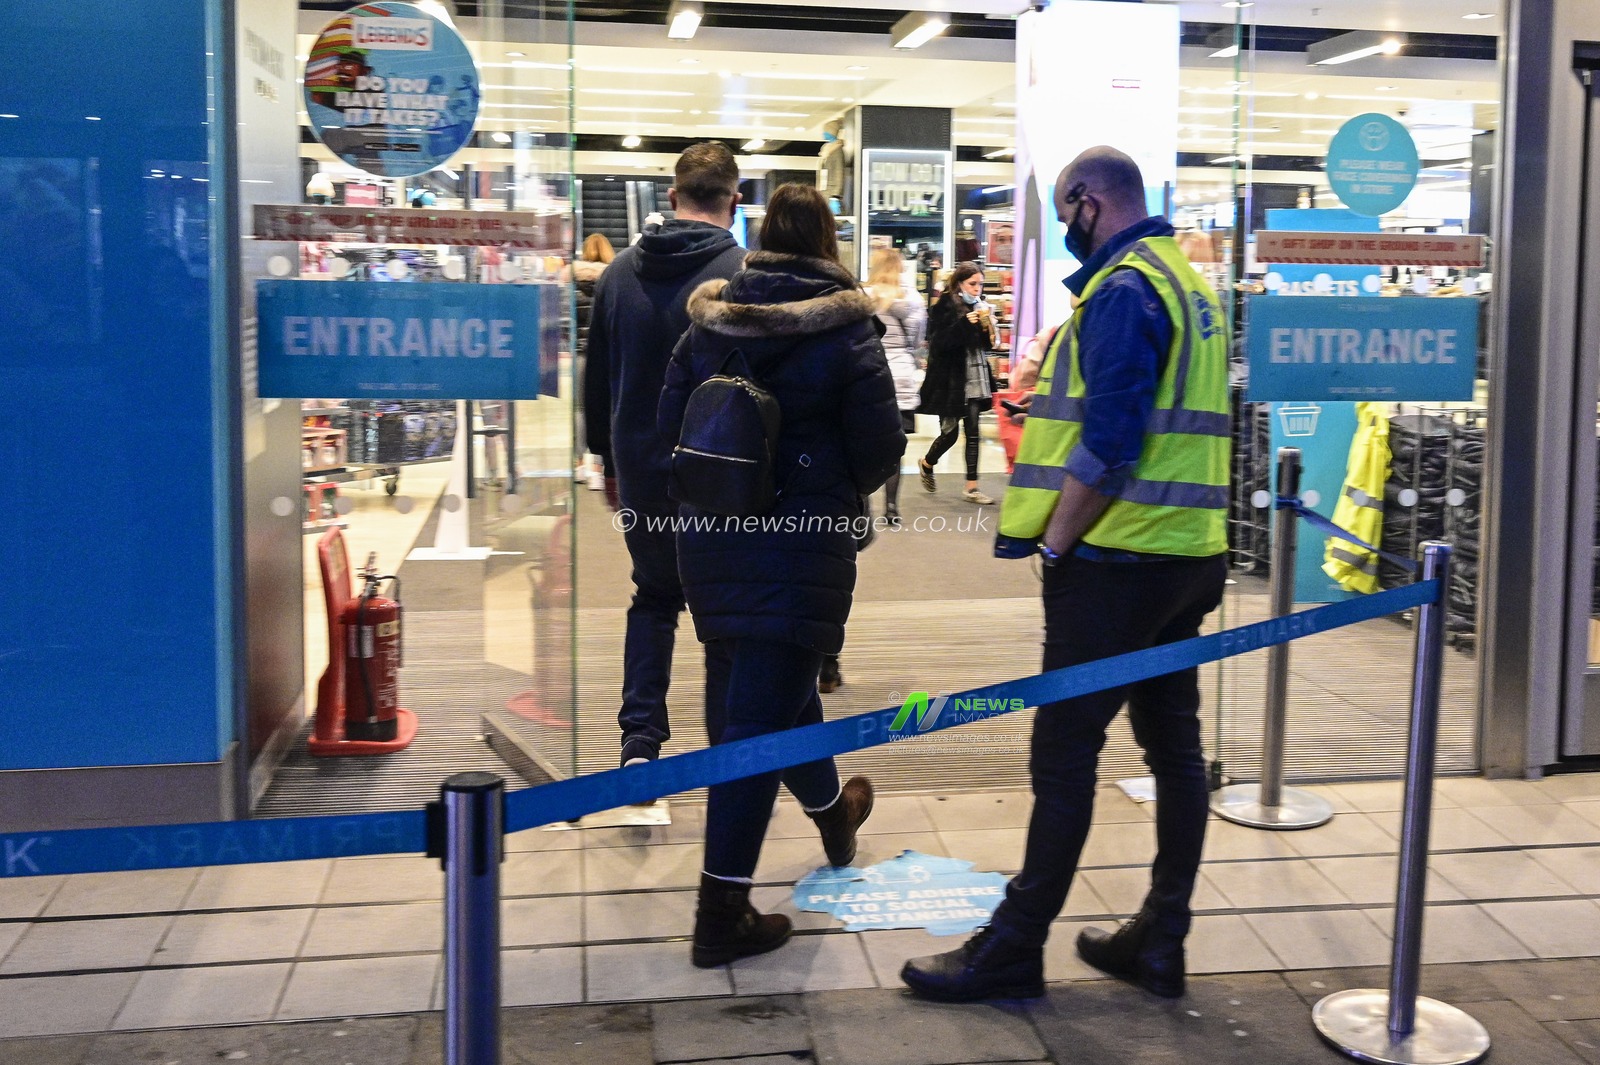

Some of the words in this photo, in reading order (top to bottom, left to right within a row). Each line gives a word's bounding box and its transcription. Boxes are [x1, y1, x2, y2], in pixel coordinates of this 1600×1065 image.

[355, 75, 386, 91] DO
[387, 77, 429, 94] YOU
[335, 91, 388, 108] HAVE
[1357, 240, 1376, 250] THE
[283, 315, 515, 359] ENTRANCE
[1268, 327, 1457, 364] ENTRANCE
[808, 891, 900, 904] PLEASE
[906, 886, 1004, 899] ADHERE
[850, 903, 880, 913] TO
[888, 898, 974, 911] SOCIAL
[841, 908, 991, 924] DISTANCING
